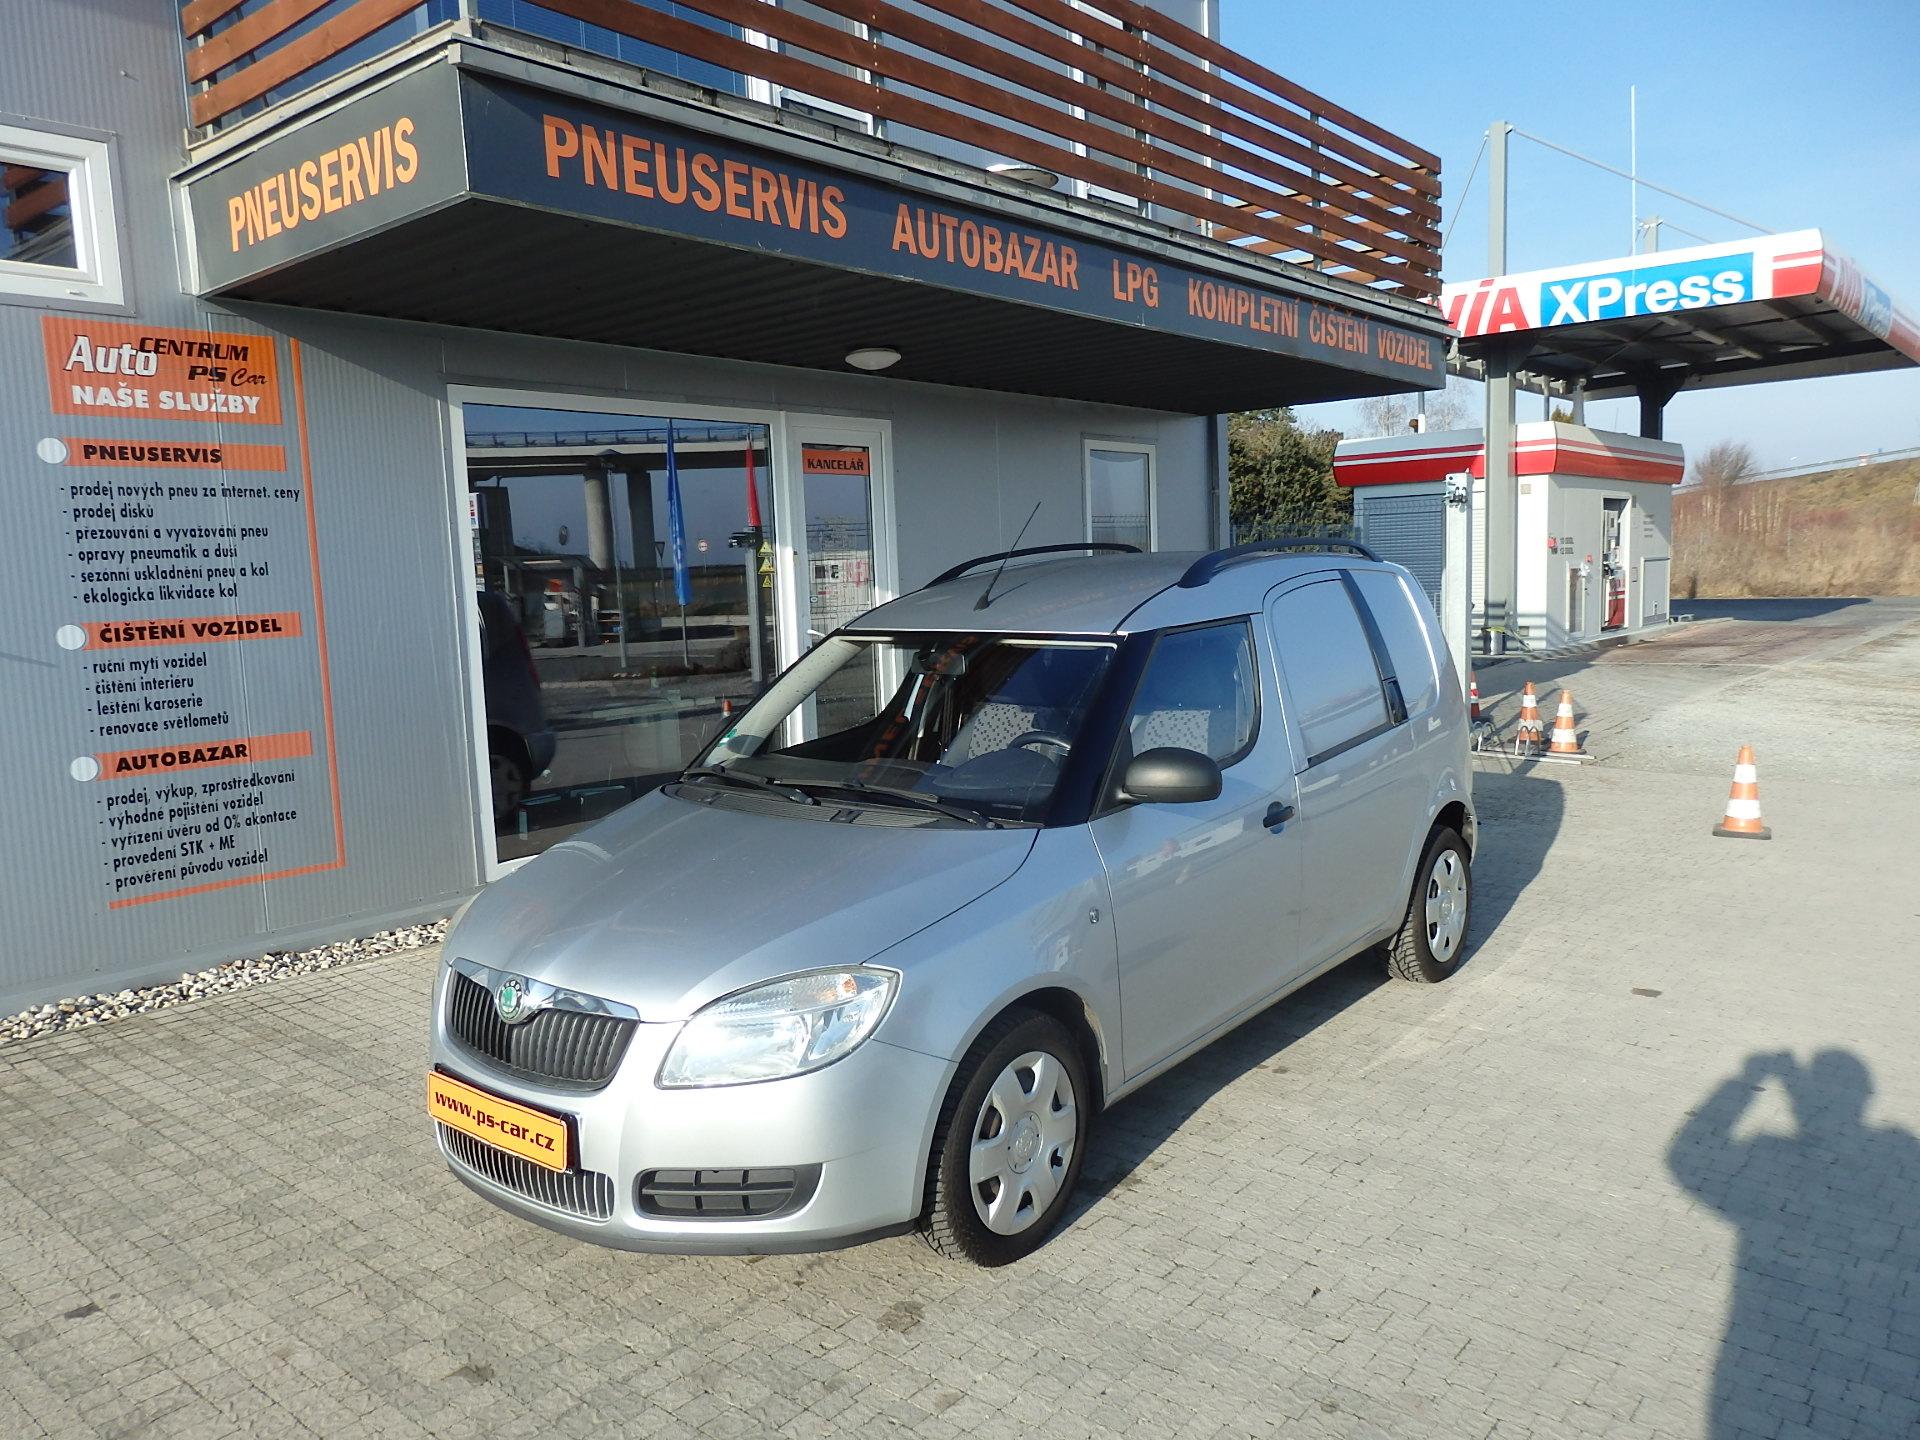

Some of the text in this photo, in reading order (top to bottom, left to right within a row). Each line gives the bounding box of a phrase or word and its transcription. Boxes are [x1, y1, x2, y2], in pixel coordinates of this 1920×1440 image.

[227, 116, 418, 253] PNEUSERVIS
[542, 114, 1432, 370] PNEUSERVIS AUTOBAZAR LPG KOMPLETNÍ ČIŠTĚNÍ VOZIDEL
[1549, 270, 1744, 326] XPress
[63, 334, 249, 377] Auto CENTRUM
[188, 365, 268, 387] PS Car
[71, 382, 260, 414] NAŠE SLUŽBY
[83, 445, 223, 463] PNEUSERVIS
[808, 458, 864, 470] KANCELÁŘ
[70, 481, 113, 500] prodej
[118, 482, 163, 500] nových
[168, 486, 198, 500] pneu
[202, 487, 216, 498] za
[274, 488, 300, 502] ceny
[73, 502, 116, 522] prodej
[154, 528, 161, 538] a
[240, 528, 268, 540] pneu
[78, 550, 124, 564] opravy
[130, 544, 197, 564] pneumatik
[202, 548, 210, 558] a
[206, 567, 236, 582] pneu
[240, 567, 246, 577] a
[250, 562, 268, 576] kol
[159, 584, 215, 600] likvidace
[219, 582, 238, 598] kol
[100, 618, 282, 643] ČIŠTĚNÍ VOZIDEL
[163, 652, 208, 668] vozidel
[144, 693, 203, 712] karoserie
[100, 721, 158, 736] renovace
[116, 743, 248, 773] AUTOBAZAR
[223, 791, 264, 810] vozidel
[206, 817, 220, 832] od
[224, 814, 240, 830] 0%
[245, 810, 296, 826] akontace
[180, 840, 204, 856] STK
[220, 834, 236, 850] ME
[228, 848, 268, 868] vozidel
[435, 1090, 555, 1152] www.ps-car.cz
